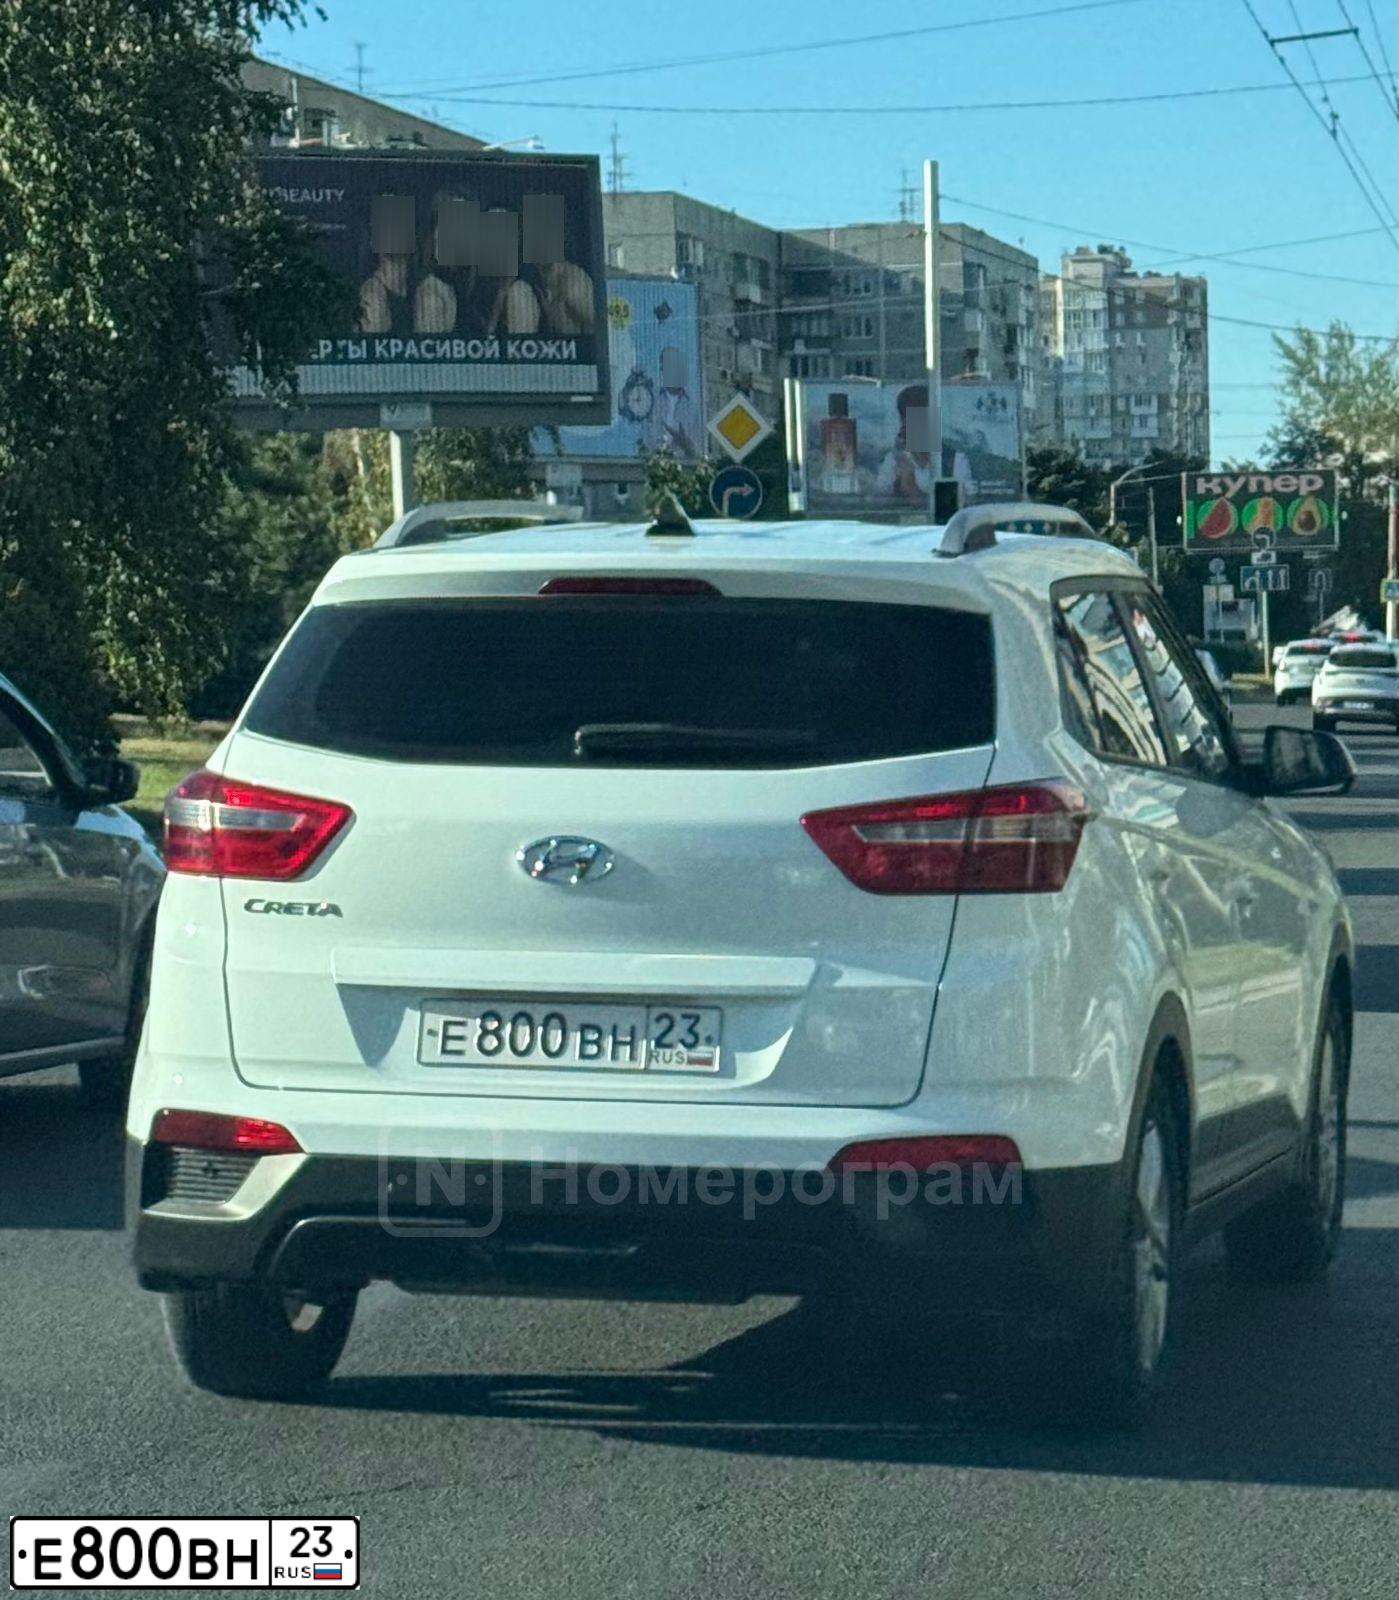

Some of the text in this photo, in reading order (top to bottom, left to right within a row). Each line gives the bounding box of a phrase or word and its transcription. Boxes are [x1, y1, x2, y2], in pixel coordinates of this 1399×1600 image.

[374, 335, 501, 359] КРАСИВОЙ
[506, 339, 577, 359] КОЖИ
[243, 898, 343, 918] CRETA
[654, 1012, 701, 1050] 23
[650, 1050, 686, 1065] RUS
